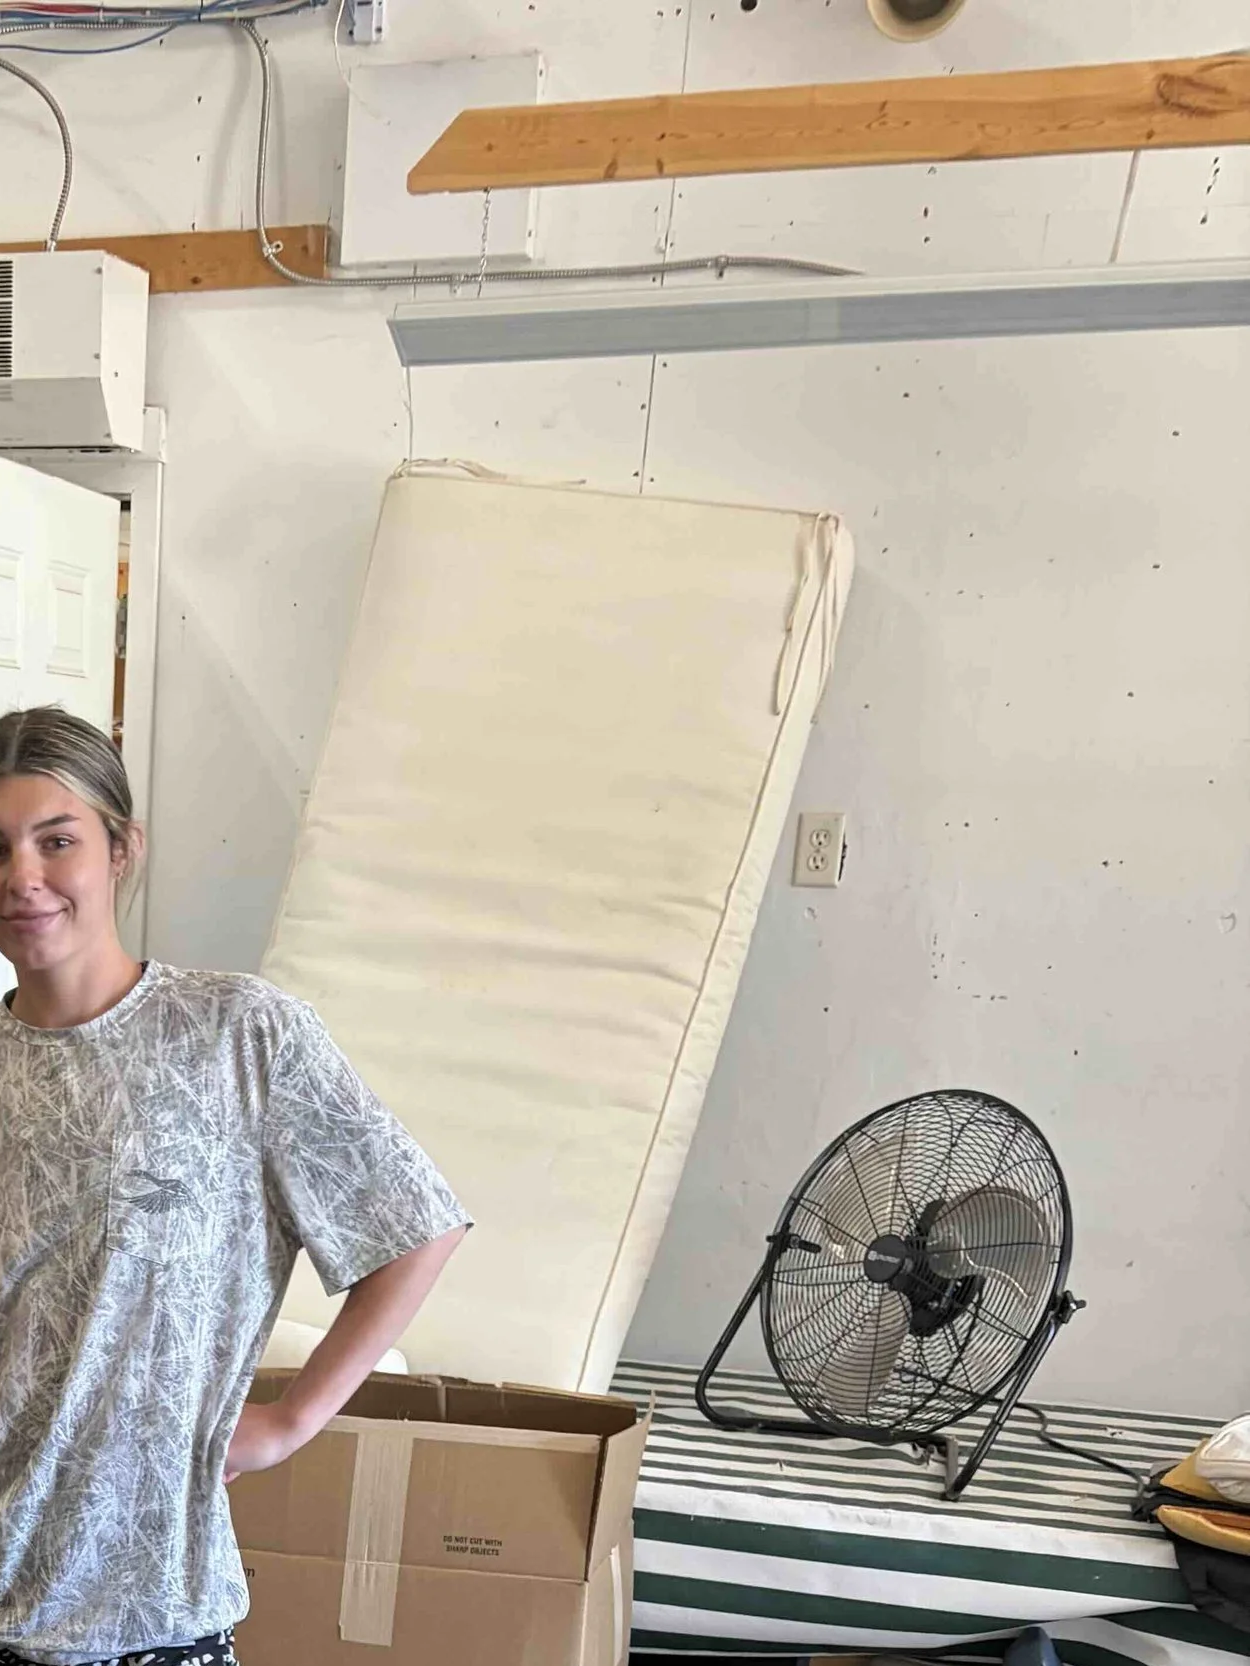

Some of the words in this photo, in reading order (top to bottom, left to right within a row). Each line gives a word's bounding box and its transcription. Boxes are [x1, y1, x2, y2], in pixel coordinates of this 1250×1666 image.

[443, 1535, 453, 1543] DO
[454, 1536, 468, 1544] NOT
[469, 1537, 483, 1545] CUT
[484, 1538, 503, 1547] WITH
[469, 1547, 500, 1556] OBJECTS
